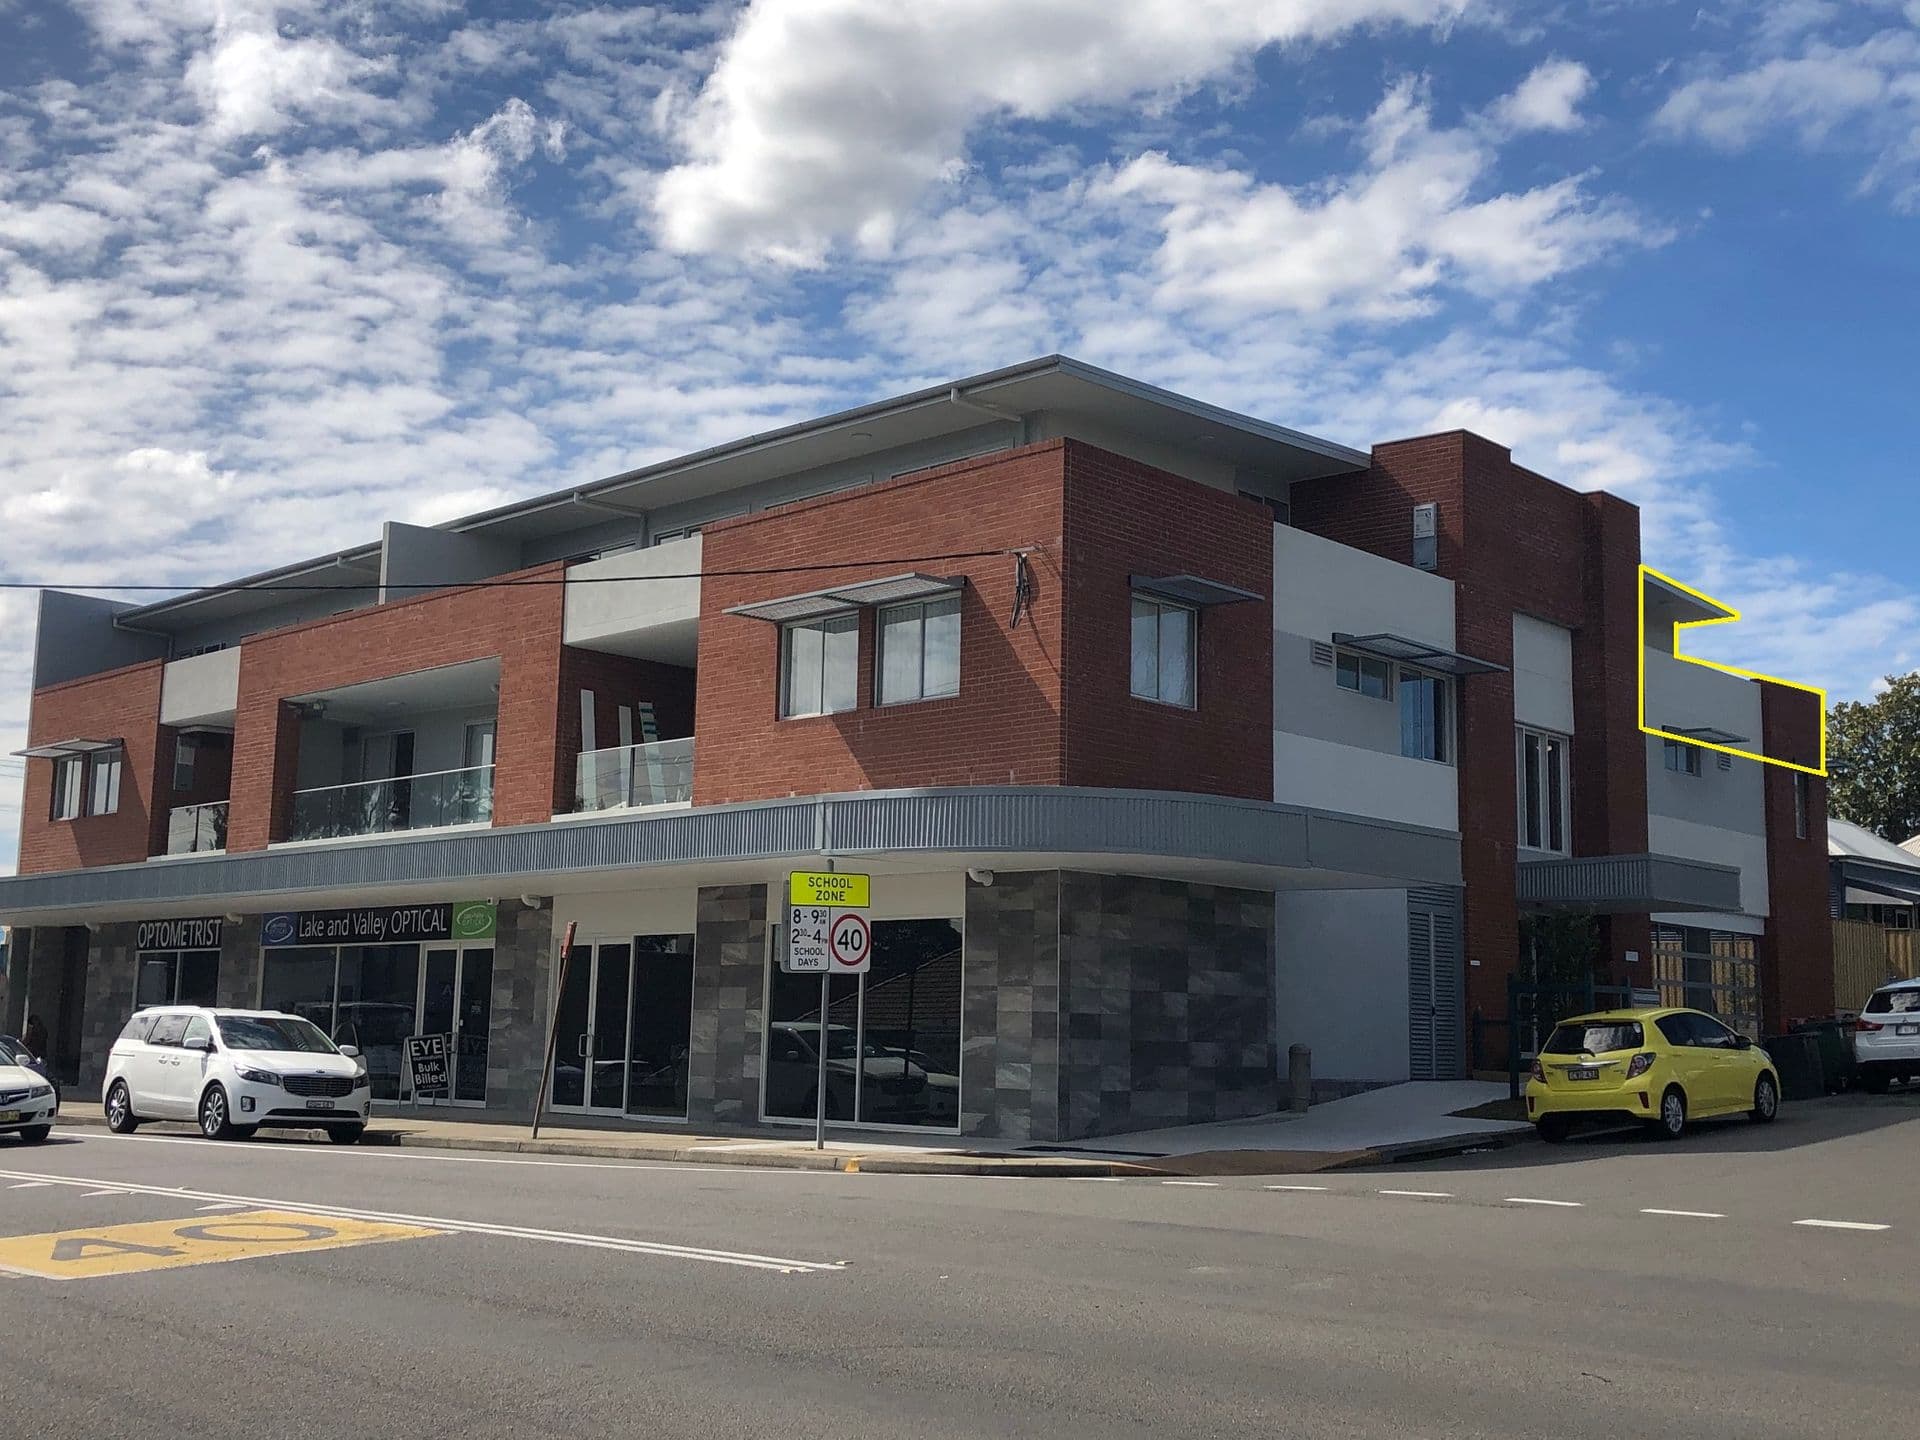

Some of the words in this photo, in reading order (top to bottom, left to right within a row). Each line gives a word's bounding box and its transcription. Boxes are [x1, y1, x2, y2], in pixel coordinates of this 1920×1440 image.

[808, 876, 853, 888] SCHOOL
[815, 890, 846, 901] ZONE
[299, 913, 325, 938] Lake
[327, 912, 350, 936] and
[352, 910, 388, 941] Valley
[391, 908, 448, 934] OPTICAL
[137, 919, 222, 948] OPTOMETRIST
[837, 929, 862, 951] 40
[794, 947, 825, 956] SCHOOL
[798, 958, 819, 966] DAYS
[410, 1039, 442, 1056] EYE
[418, 1061, 440, 1072] Bulk
[415, 1071, 446, 1085] Billed
